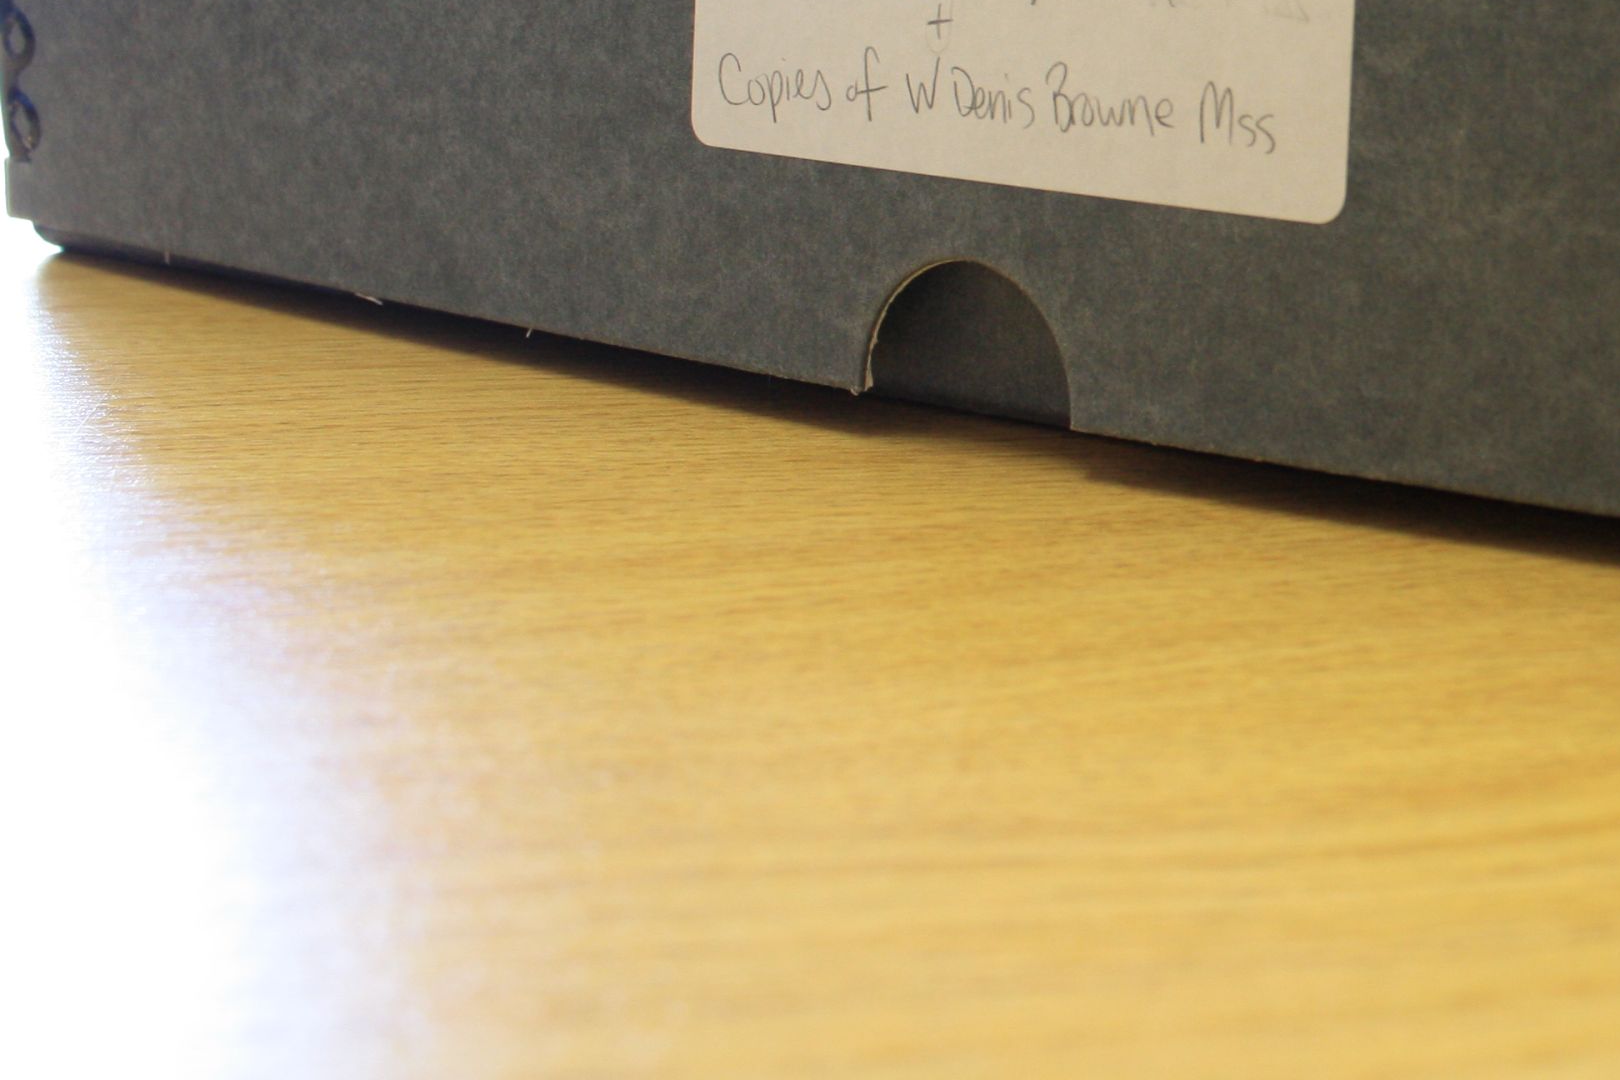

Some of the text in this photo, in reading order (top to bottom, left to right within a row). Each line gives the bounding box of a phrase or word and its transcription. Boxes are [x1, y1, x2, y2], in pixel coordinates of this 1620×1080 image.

[926, 3, 954, 40] +
[718, 52, 832, 124] Copies
[845, 46, 889, 122] of
[905, 56, 941, 114] W
[951, 66, 1036, 129] Denis
[1046, 61, 1175, 137] Browne
